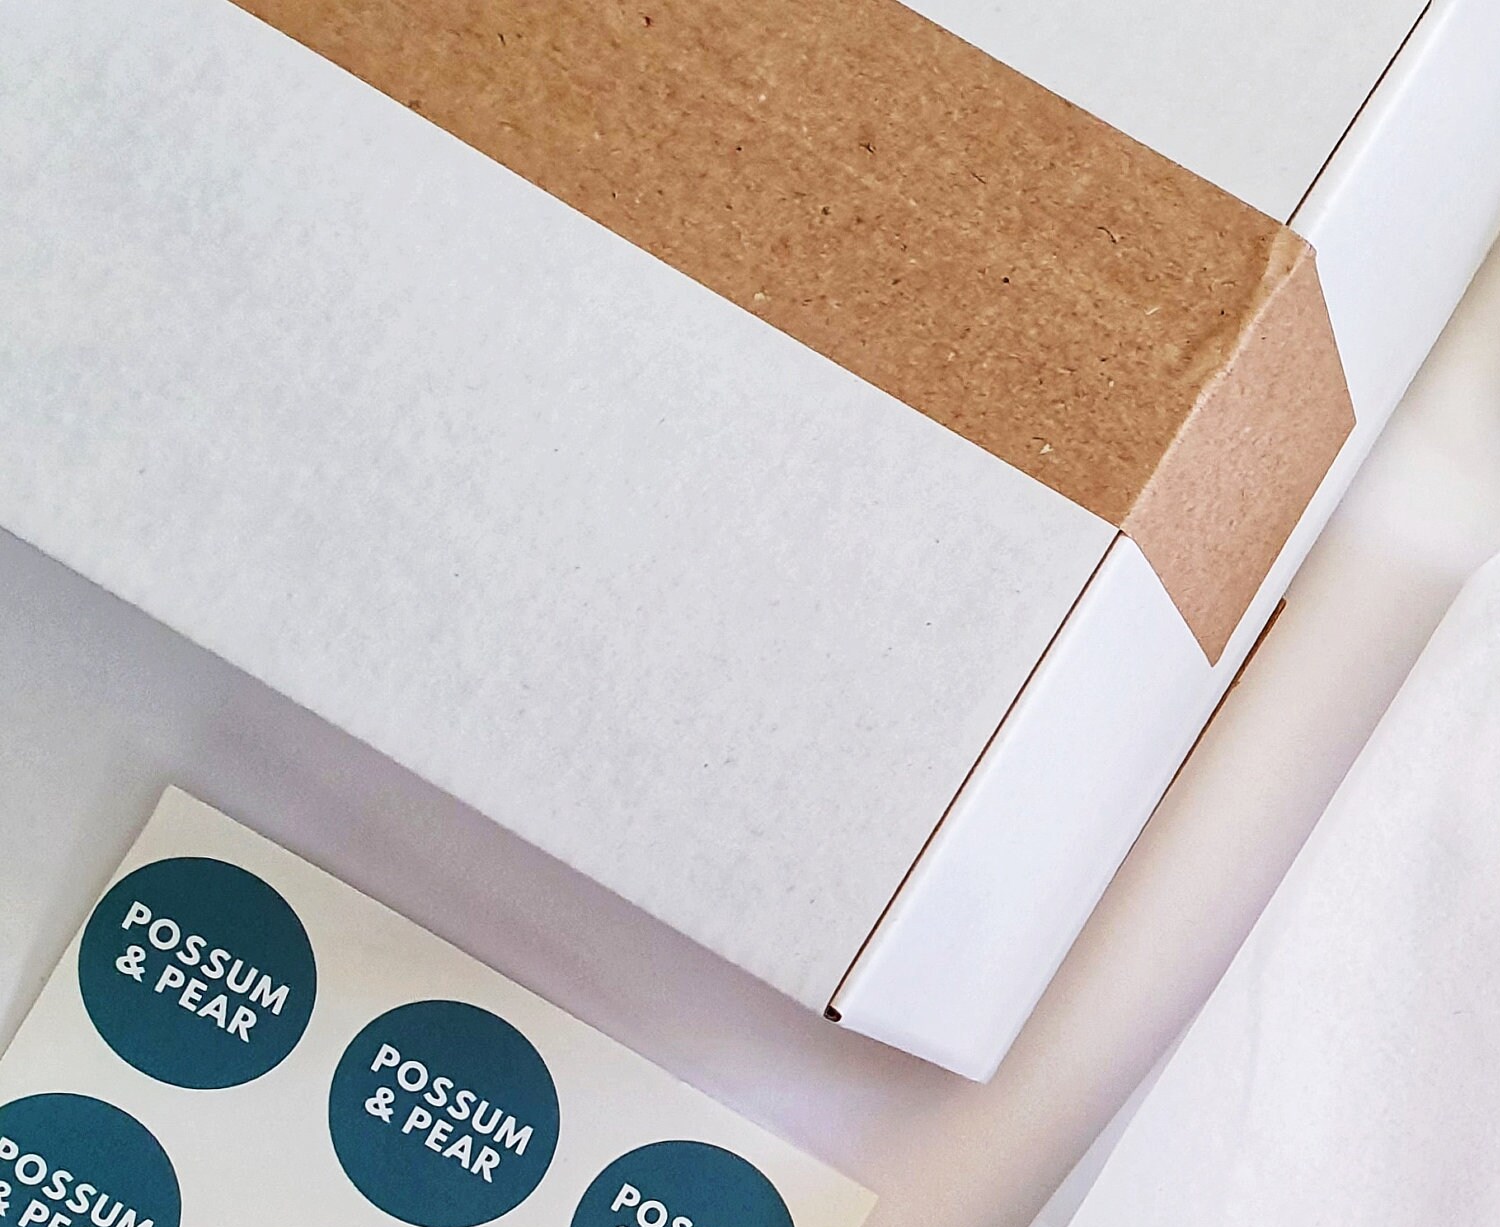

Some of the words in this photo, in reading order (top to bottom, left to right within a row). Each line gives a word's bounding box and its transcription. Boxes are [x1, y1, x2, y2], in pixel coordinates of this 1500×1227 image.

[115, 945, 146, 983] &
[154, 964, 257, 1043] PEAR
[121, 900, 290, 1016] POSSUM
[364, 1086, 395, 1124] &
[401, 1105, 501, 1183] PEAR
[370, 1043, 534, 1156] POSSUM
